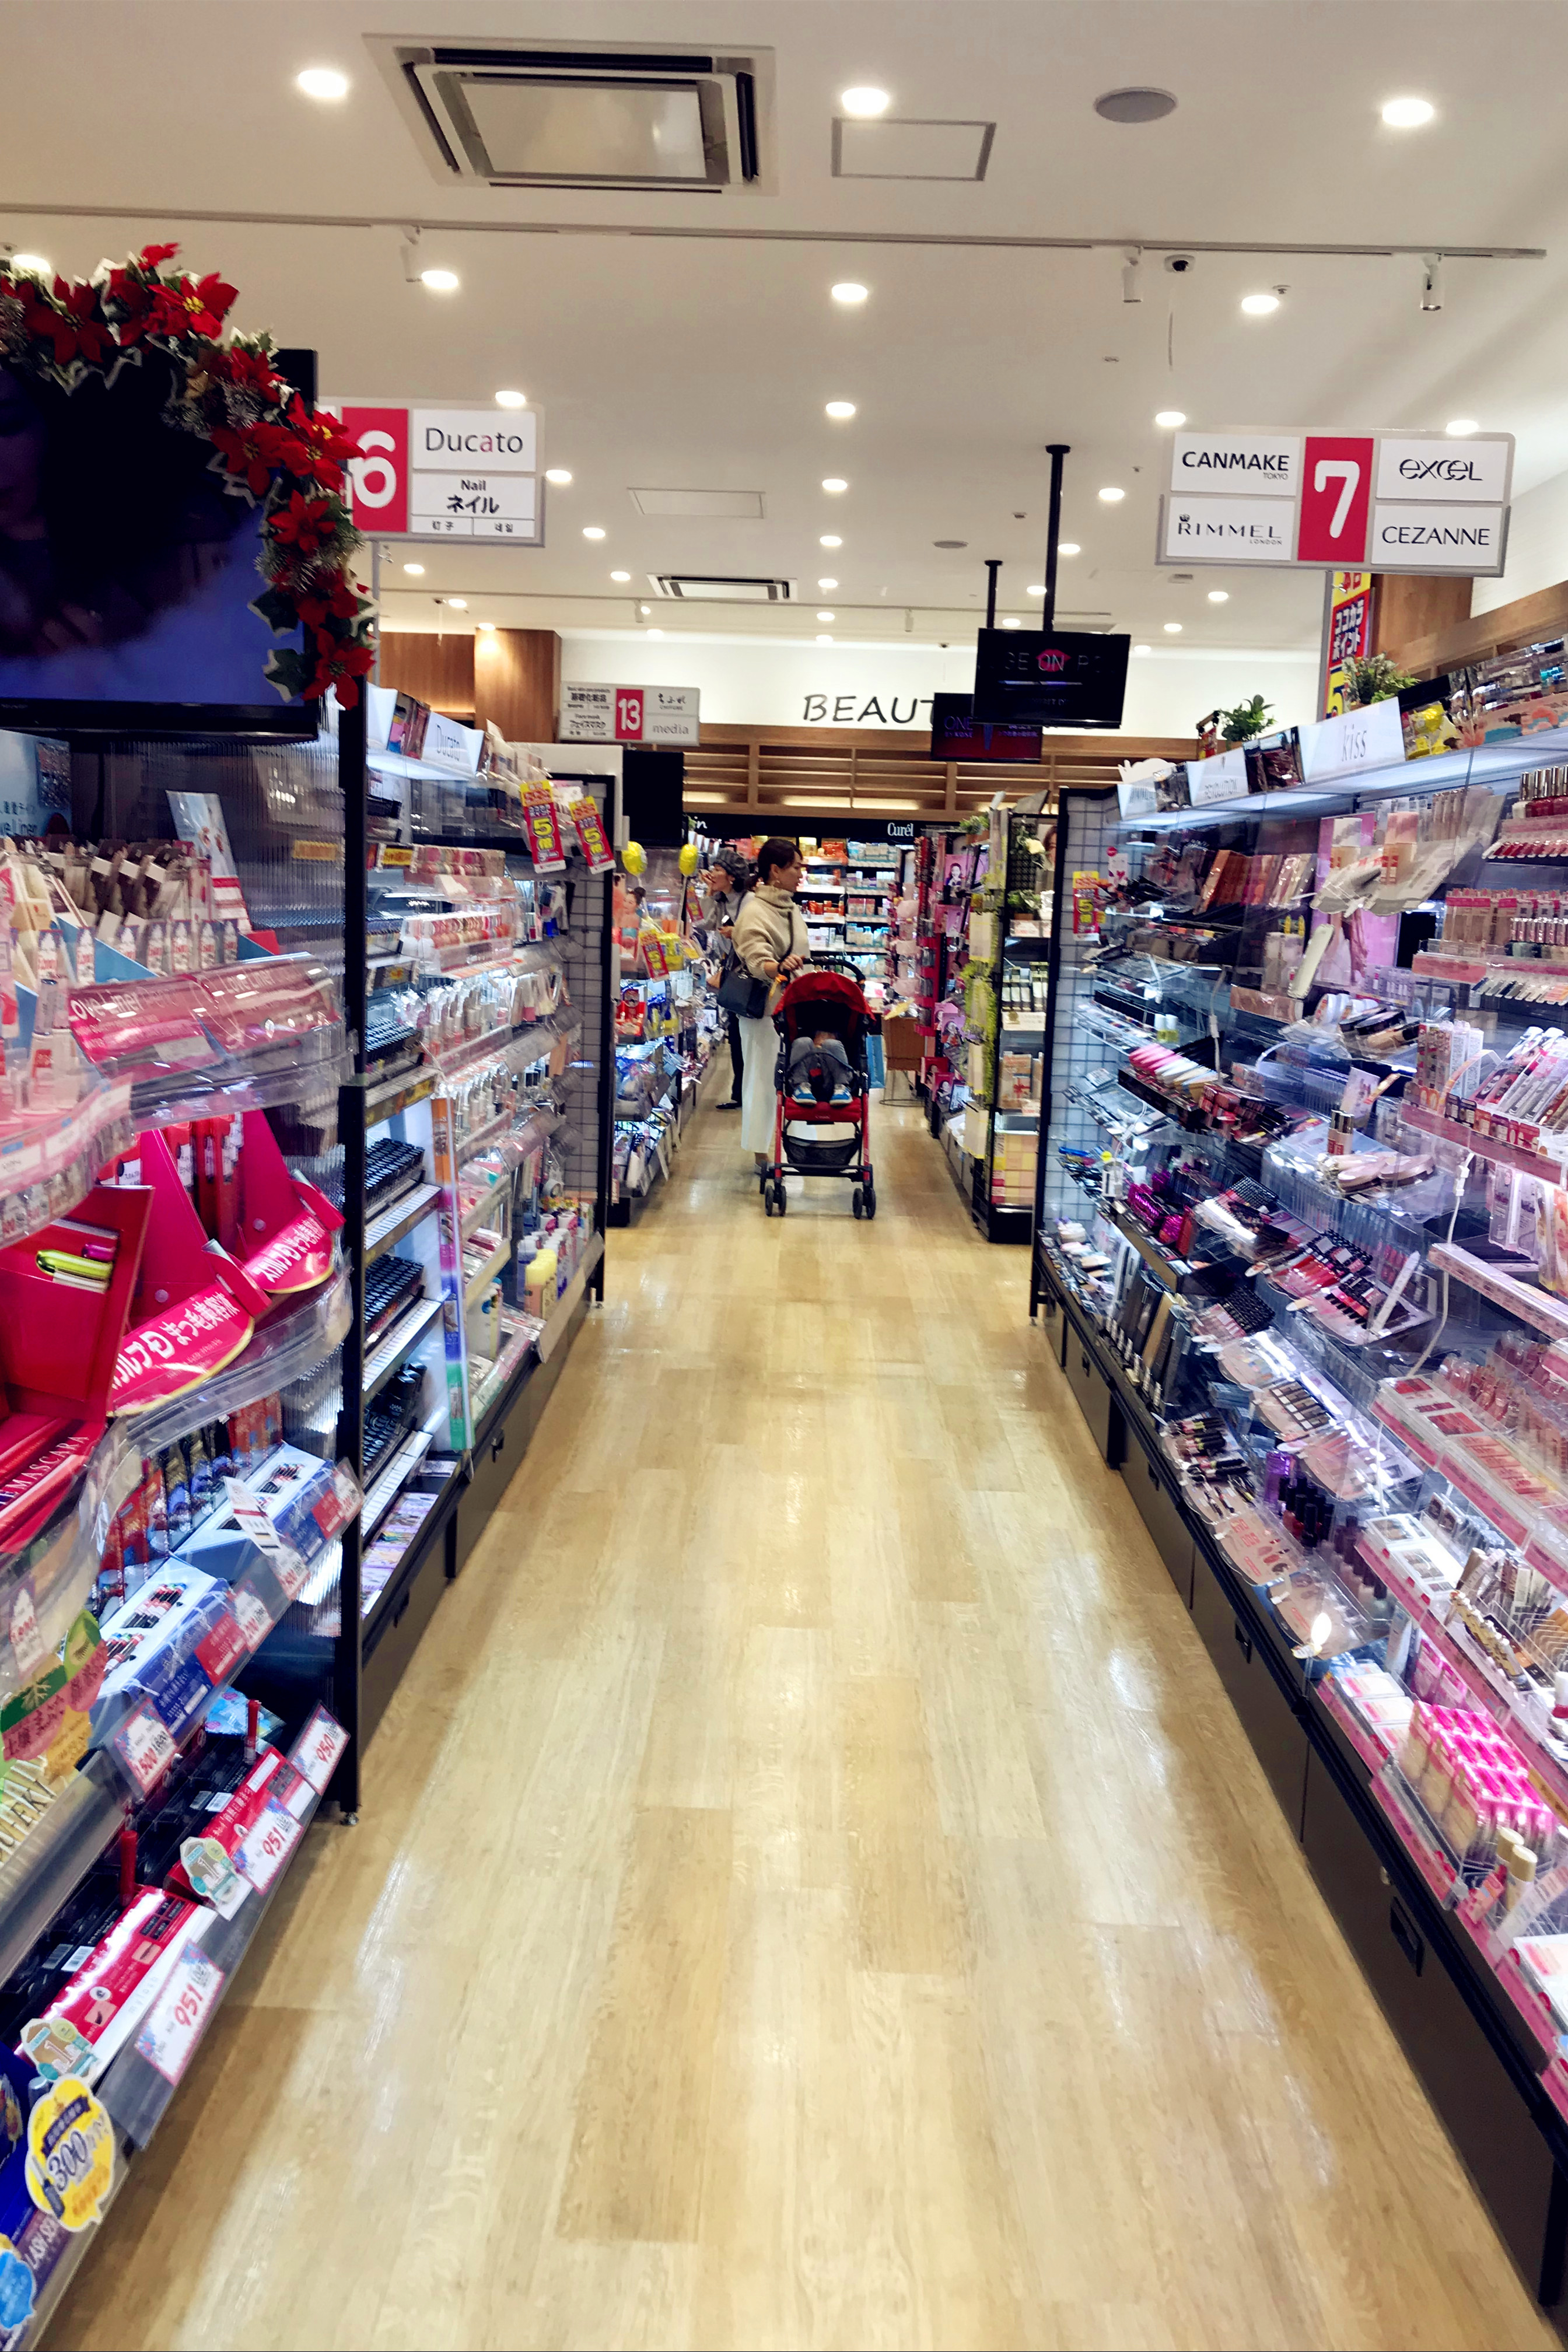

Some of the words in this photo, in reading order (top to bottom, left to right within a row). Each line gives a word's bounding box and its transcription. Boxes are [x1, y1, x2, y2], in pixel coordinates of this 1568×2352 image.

[425, 428, 524, 453] Ducato
[352, 429, 397, 508] 6
[1182, 450, 1290, 472] CANMAKE
[461, 479, 487, 492] Nail
[1263, 471, 1289, 481] TOKYO
[447, 495, 500, 514] ネイル
[1314, 460, 1360, 539] 7
[1177, 519, 1282, 540] RIMMEL
[1381, 525, 1490, 546] CEZANNE
[1038, 653, 1065, 672] ON
[618, 698, 640, 731] 13
[653, 723, 690, 734] media
[436, 724, 460, 761] Ducato
[1342, 724, 1367, 761] kiss
[887, 822, 914, 837] Curél
[5, 1436, 90, 1490] MASCARA
[316, 1733, 337, 1764] 950
[262, 1826, 286, 1857] 951
[174, 1983, 204, 2026] 951
[47, 2130, 88, 2192] 300
